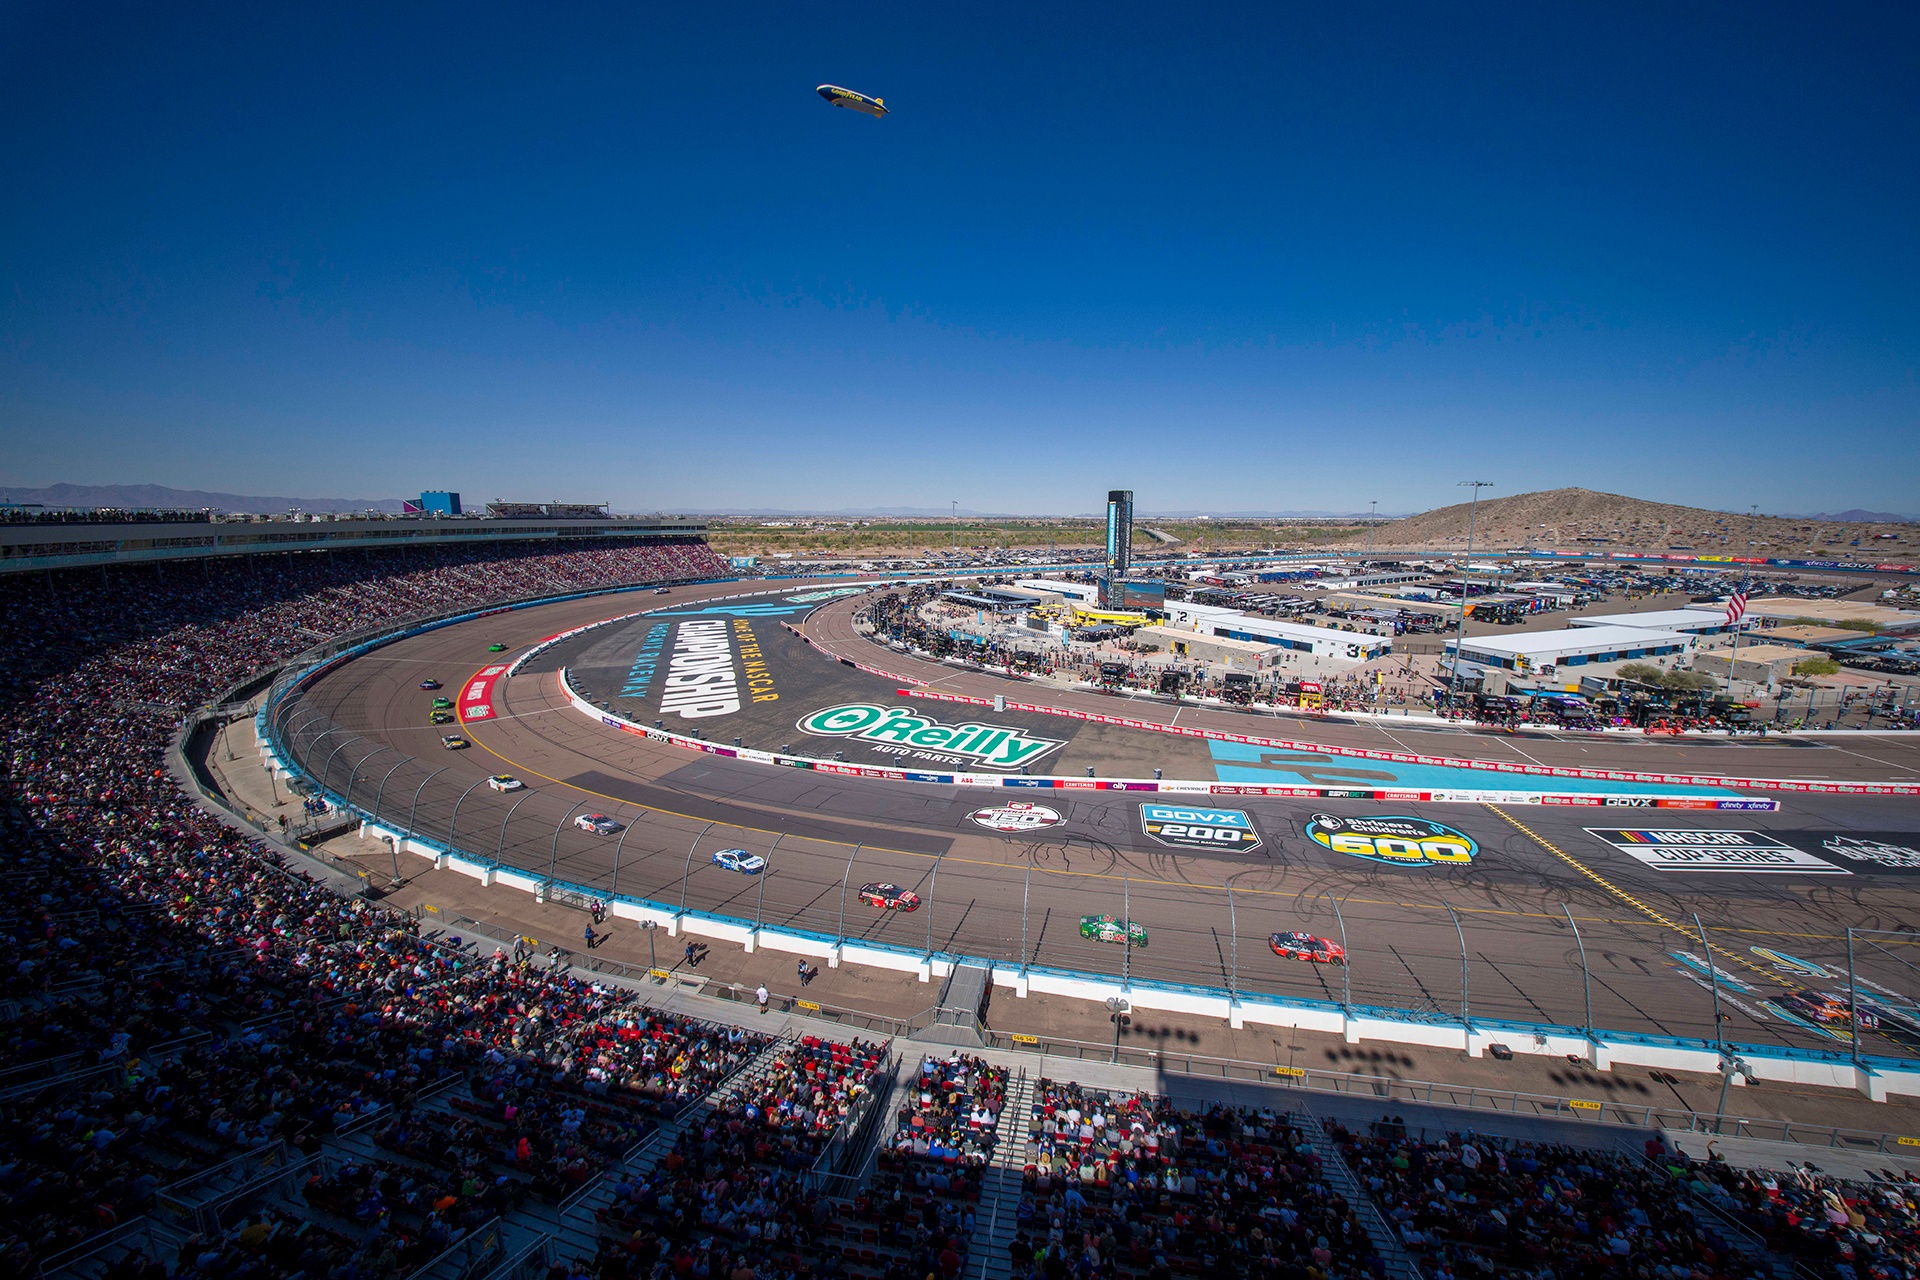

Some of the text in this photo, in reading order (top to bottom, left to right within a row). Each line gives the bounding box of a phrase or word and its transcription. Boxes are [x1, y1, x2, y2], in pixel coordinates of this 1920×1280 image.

[642, 623, 669, 651] PHOENIX
[736, 633, 756, 642] OF
[1689, 636, 1697, 649] 4
[739, 643, 762, 659] THE
[1346, 644, 1360, 658] 3
[618, 652, 660, 698] RACEWAY
[659, 619, 741, 718] CHAMPIONSHIP
[743, 660, 779, 704] NASCAR
[808, 704, 1055, 766] O'Reilly
[871, 744, 963, 764] AUTO PARTS
[1112, 782, 1127, 791] ally
[1606, 798, 1652, 807] GOVX
[1747, 802, 1771, 810] xfinity
[989, 811, 1042, 824] 150
[1152, 809, 1239, 825] GOVX
[1344, 818, 1414, 830] Shriners
[1160, 824, 1241, 842] 200
[1350, 824, 1428, 837] Children's
[1649, 831, 1754, 845] NASCAR
[1653, 848, 1796, 862] CUP SERIES
